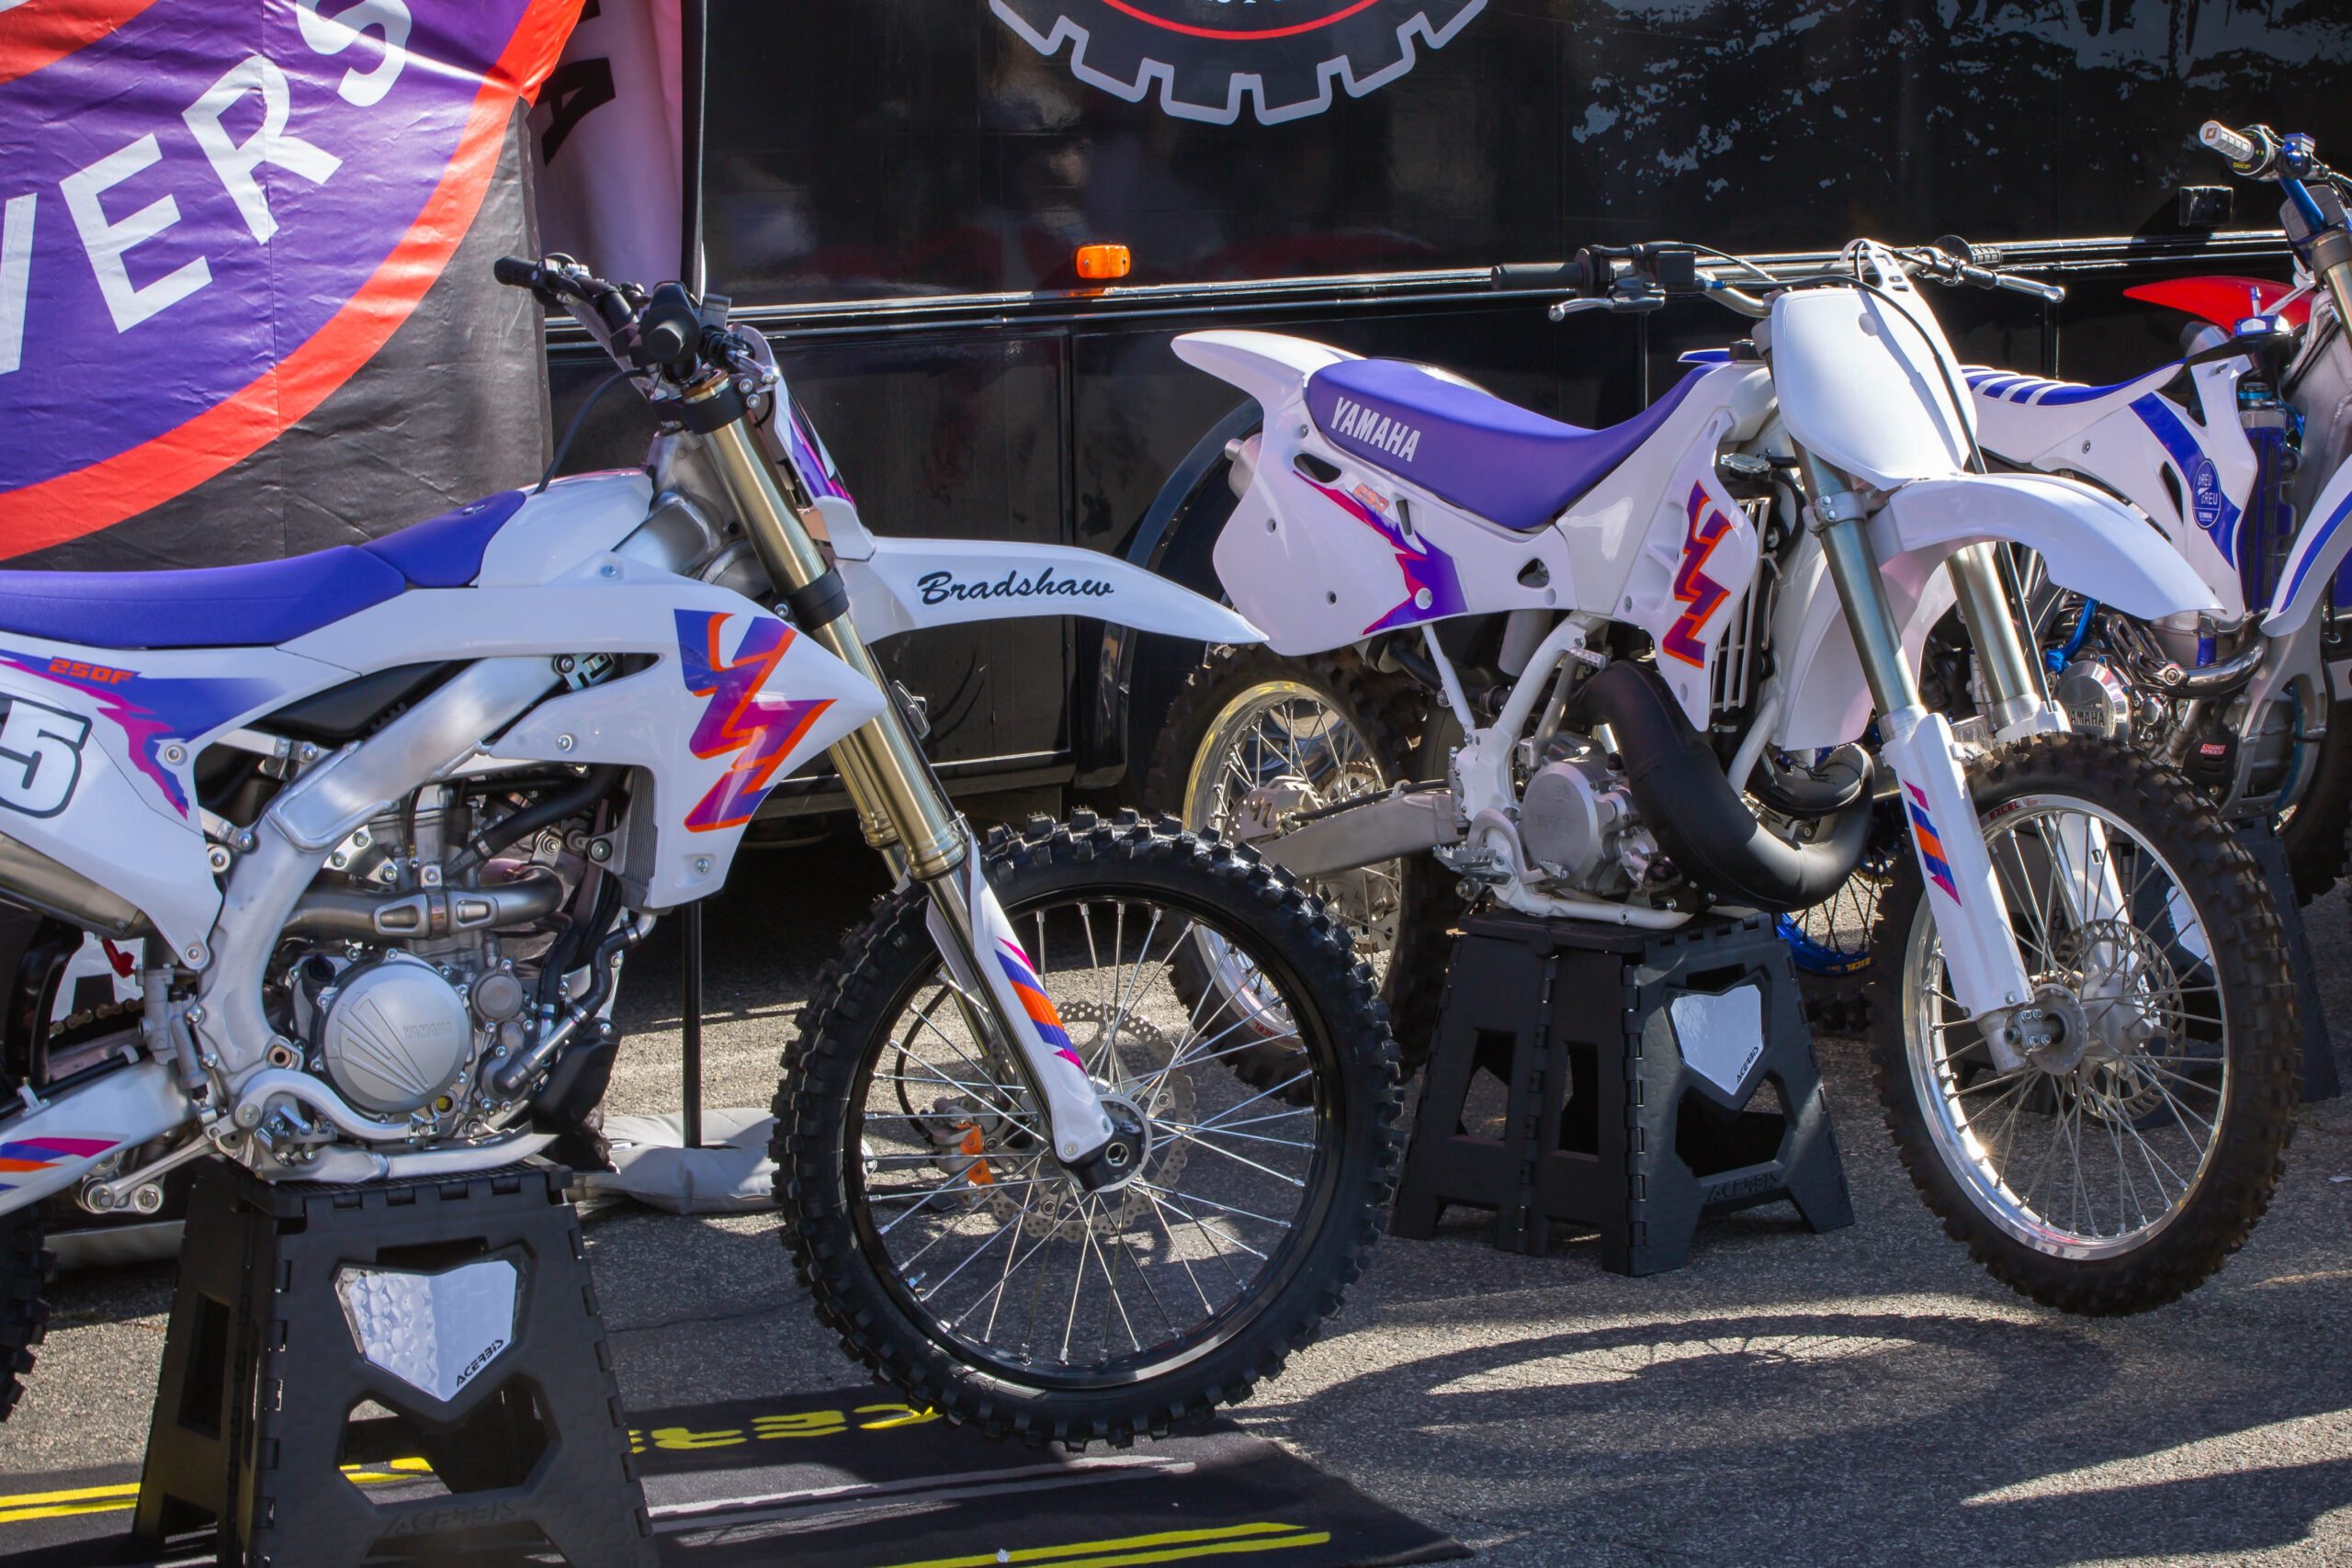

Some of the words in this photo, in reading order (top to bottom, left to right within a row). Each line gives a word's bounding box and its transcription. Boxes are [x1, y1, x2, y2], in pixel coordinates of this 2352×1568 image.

[1330, 396, 1421, 463] YAMAHA
[1352, 483, 1390, 513] 250
[917, 567, 1114, 605] Bradshaw
[49, 658, 135, 684] 250F
[1988, 800, 2021, 821] EXCEL
[456, 1338, 503, 1388] ACERBIS
